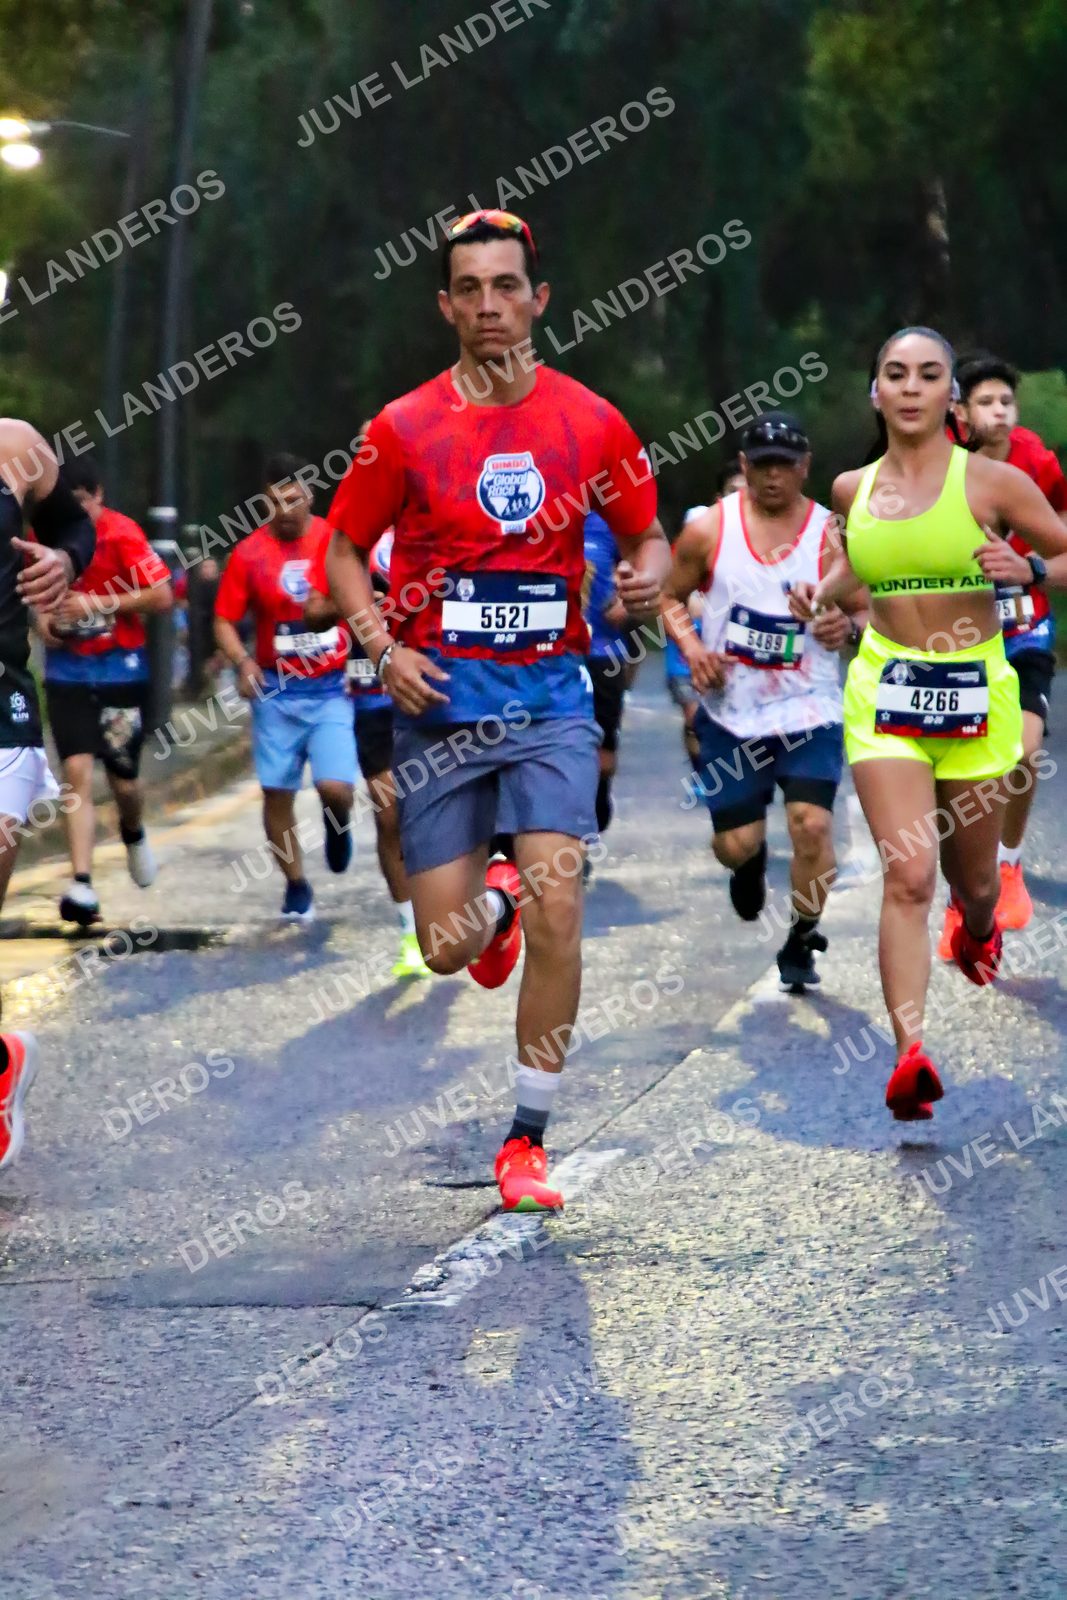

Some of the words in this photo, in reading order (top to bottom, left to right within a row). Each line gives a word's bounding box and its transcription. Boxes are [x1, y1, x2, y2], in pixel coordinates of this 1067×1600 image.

[493, 472, 528, 485] Global
[488, 485, 516, 497] Race
[881, 577, 955, 592] UNDER
[481, 605, 531, 629] 5521
[748, 630, 783, 651] 5489
[910, 689, 959, 711] 4266
